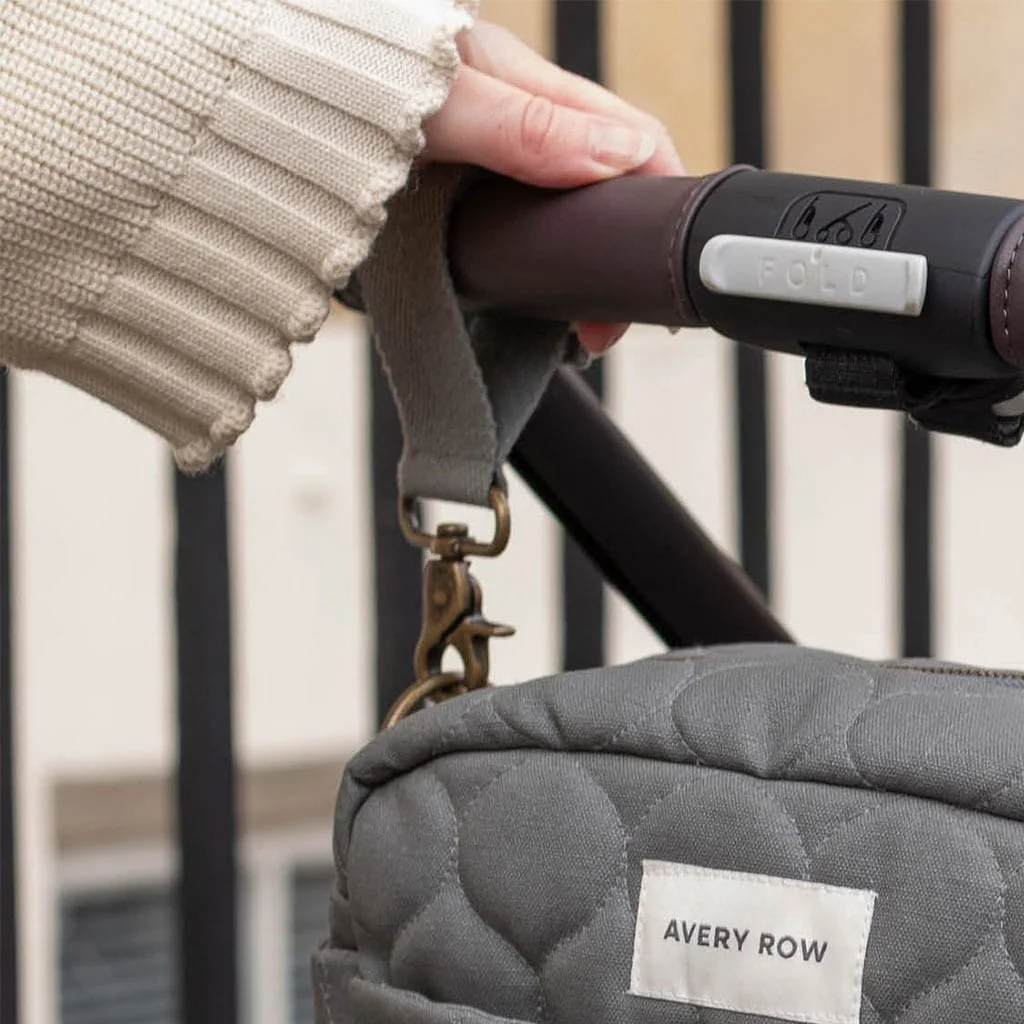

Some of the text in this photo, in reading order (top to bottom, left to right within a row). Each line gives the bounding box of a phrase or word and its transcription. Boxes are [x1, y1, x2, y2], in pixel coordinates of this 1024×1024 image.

[759, 256, 868, 296] FOLD
[663, 919, 828, 962] AVERY ROW
